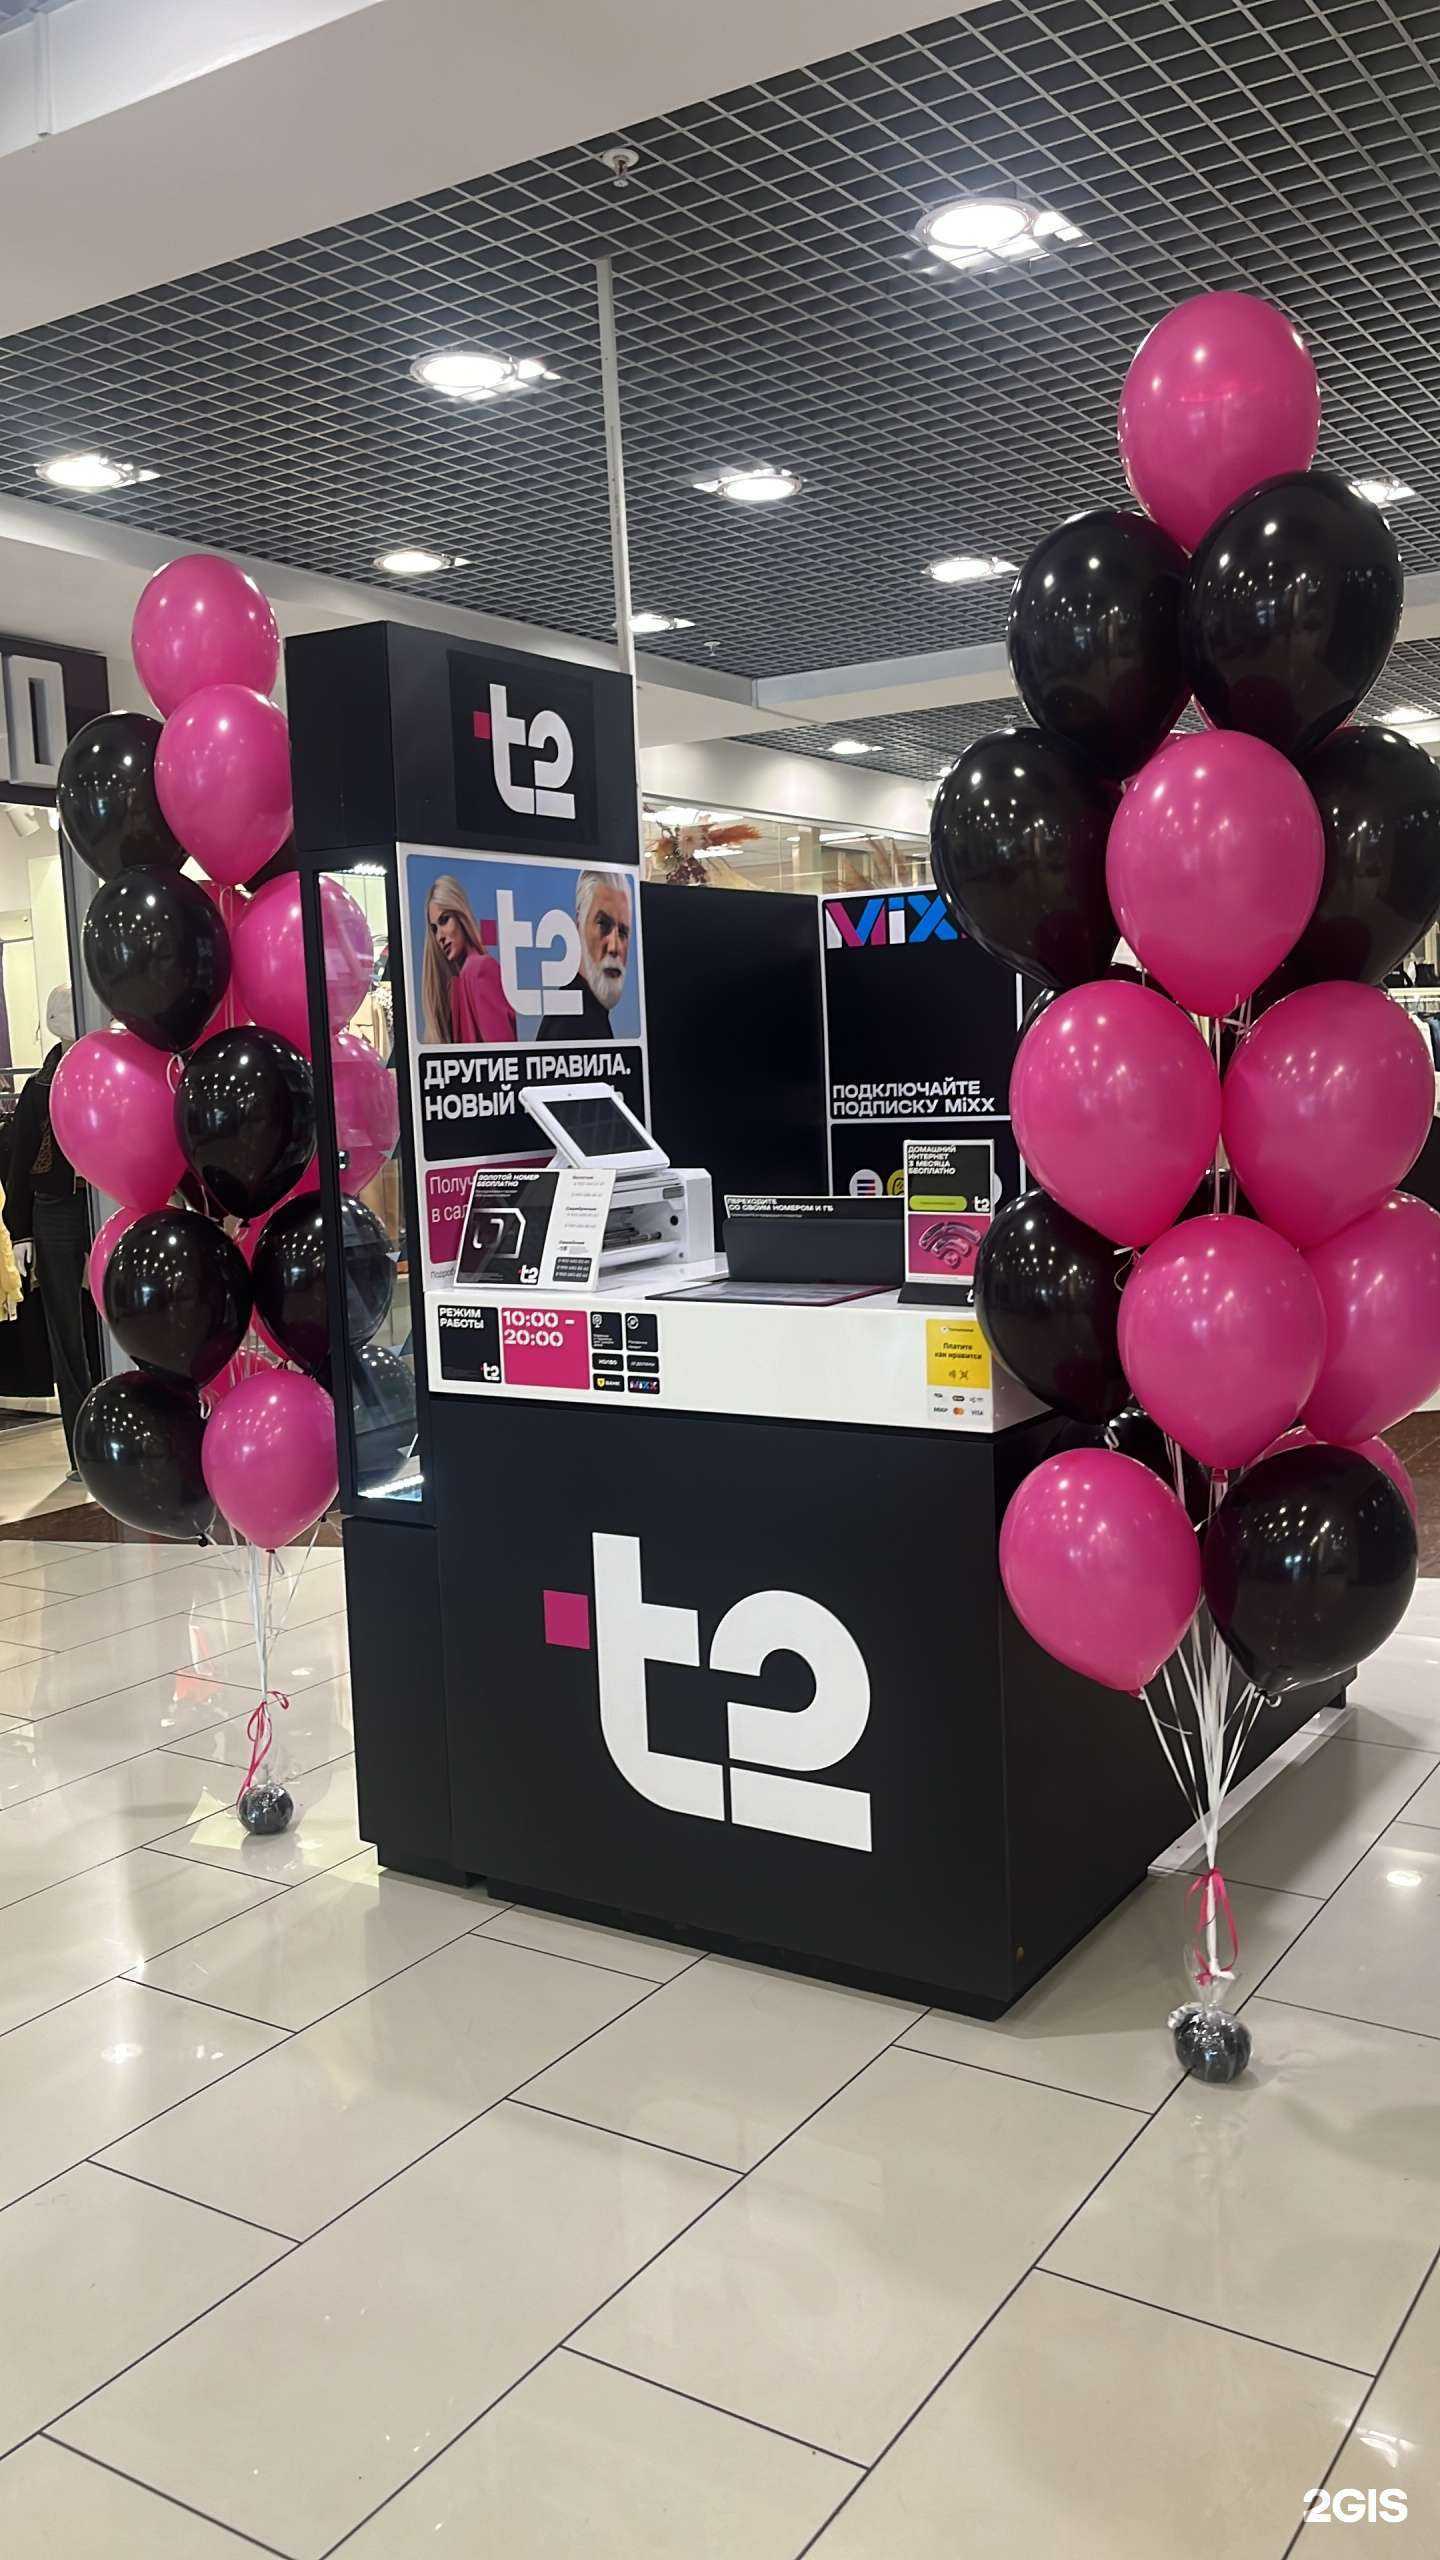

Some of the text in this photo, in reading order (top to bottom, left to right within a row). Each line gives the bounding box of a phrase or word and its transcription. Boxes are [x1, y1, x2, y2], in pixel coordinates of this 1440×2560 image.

[473, 684, 576, 820] t2
[825, 894, 968, 949] MiX
[480, 890, 584, 1016] t2
[424, 1053, 632, 1090] ДРУГИЕ ПРАВИЛА.
[833, 1077, 981, 1100] ПОДКЛЮЧАЙТЕ
[424, 1085, 516, 1121] НОВЫЙ
[833, 1097, 996, 1116] ПОДПИСКУ MiXX
[907, 1144, 957, 1154] ДОМАШНИЙ
[907, 1153, 949, 1161] ИНТЕРНЕТ
[907, 1167, 956, 1175] БЕСПЛАТНО
[915, 1160, 951, 1168] МЕСЯЦА
[476, 1180, 520, 1188] БЕСПЛАТНО
[477, 1173, 512, 1182] ЗОЛОТОЙ
[742, 1204, 771, 1212] СВОИМ
[772, 1204, 814, 1212] НОМЕРОМ
[823, 1205, 834, 1213] ГБ
[971, 1196, 990, 1212] t2
[431, 1208, 441, 1223] в
[518, 1264, 539, 1284] t2
[439, 1307, 482, 1319] РЕЖИМ
[502, 1310, 559, 1328] 10:00
[439, 1317, 485, 1329] РАБОТЫ
[503, 1328, 564, 1347] 20:00
[943, 1342, 973, 1351] Платите
[480, 1362, 501, 1381] t2
[543, 1531, 873, 1853] t2
